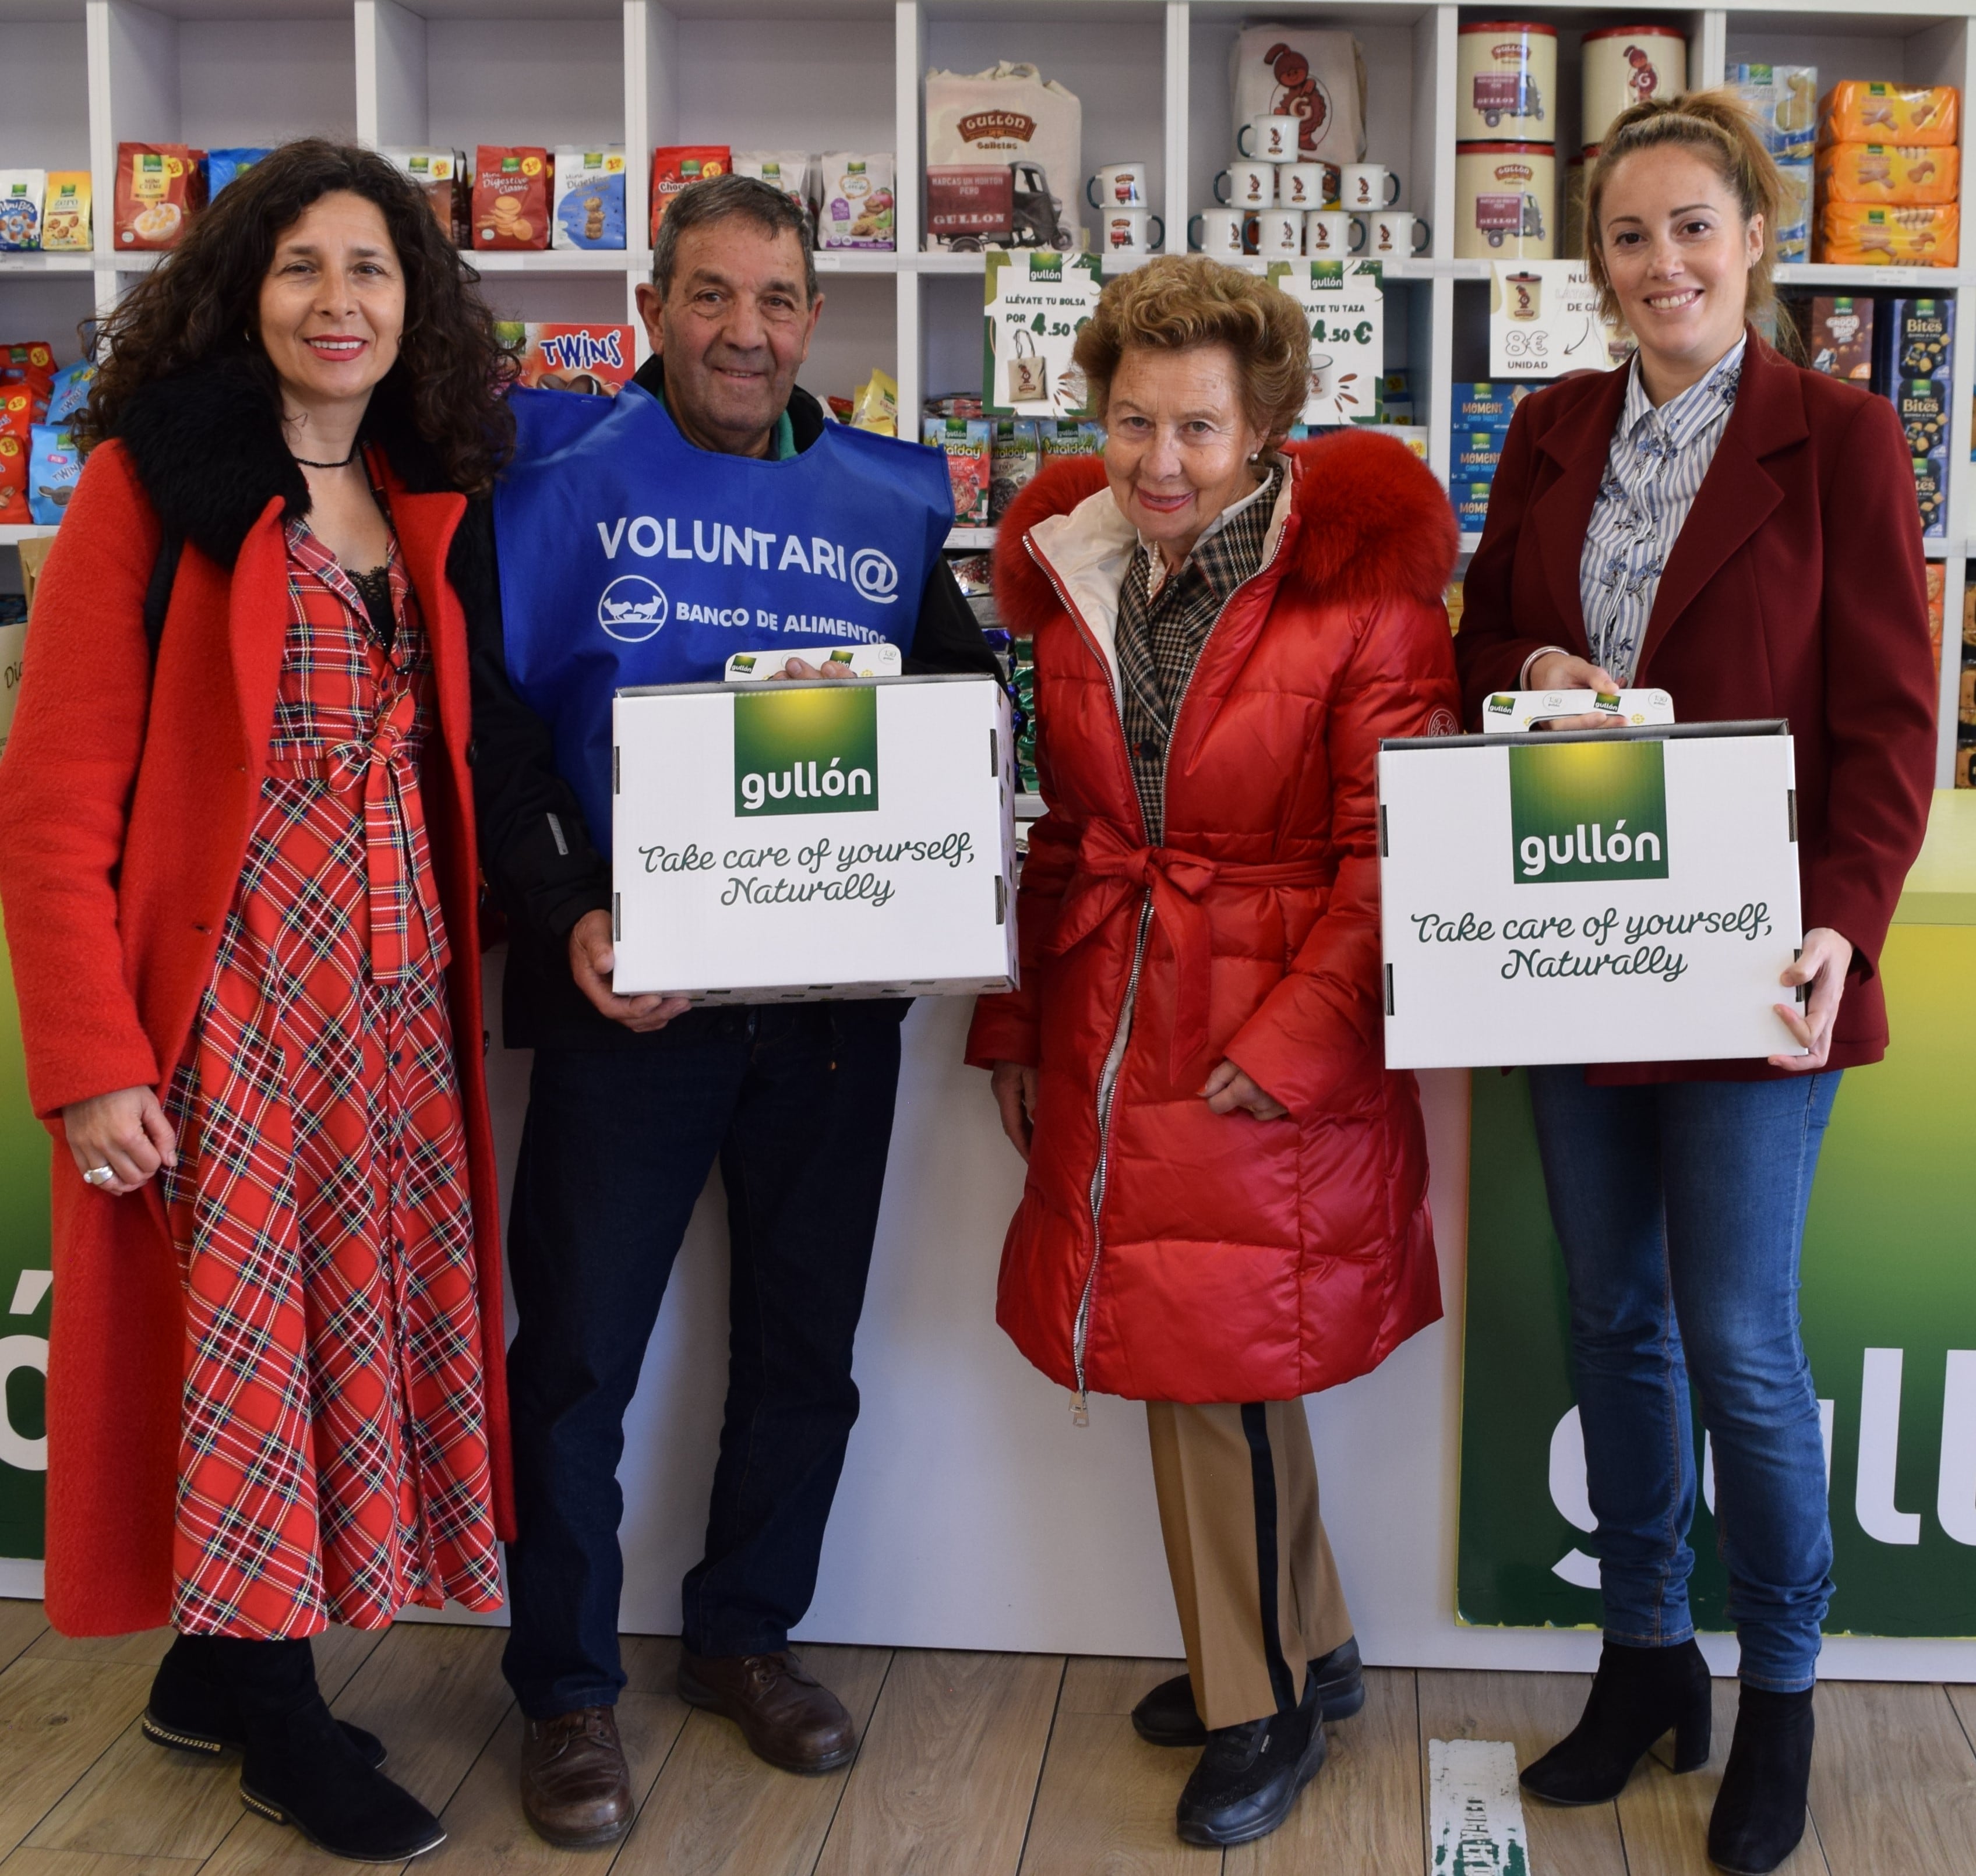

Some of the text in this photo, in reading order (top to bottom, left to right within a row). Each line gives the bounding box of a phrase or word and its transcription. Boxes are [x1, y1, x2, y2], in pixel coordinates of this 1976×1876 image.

[934, 213, 1005, 224] GULLON
[1031, 270, 1061, 281] gullón
[1312, 277, 1342, 289] gullón
[1005, 294, 1086, 306] LLÉVATE TU BOLSA
[1302, 305, 1365, 313] VATE TU TAZA
[1568, 303, 1582, 312] DE
[1006, 314, 1026, 323] POR
[1907, 318, 1943, 333] Bites
[1508, 361, 1548, 369] UNIDAD
[1903, 398, 1939, 412] Bites
[945, 443, 981, 461] alday
[1459, 503, 1488, 513] MOME
[597, 515, 899, 604] VOLUNTARI@
[676, 602, 749, 627] BANCO
[757, 610, 778, 631] DE
[731, 664, 752, 673] gullón
[1489, 705, 1512, 715] gullón
[1594, 701, 1618, 711] gullón
[741, 757, 871, 810] gullón
[638, 832, 975, 874] Take care of yourself,
[1519, 819, 1661, 876] gullón
[720, 872, 896, 907] Naturally
[1410, 902, 1773, 946] Take care of yourself,
[1500, 945, 1688, 983] Naturally
